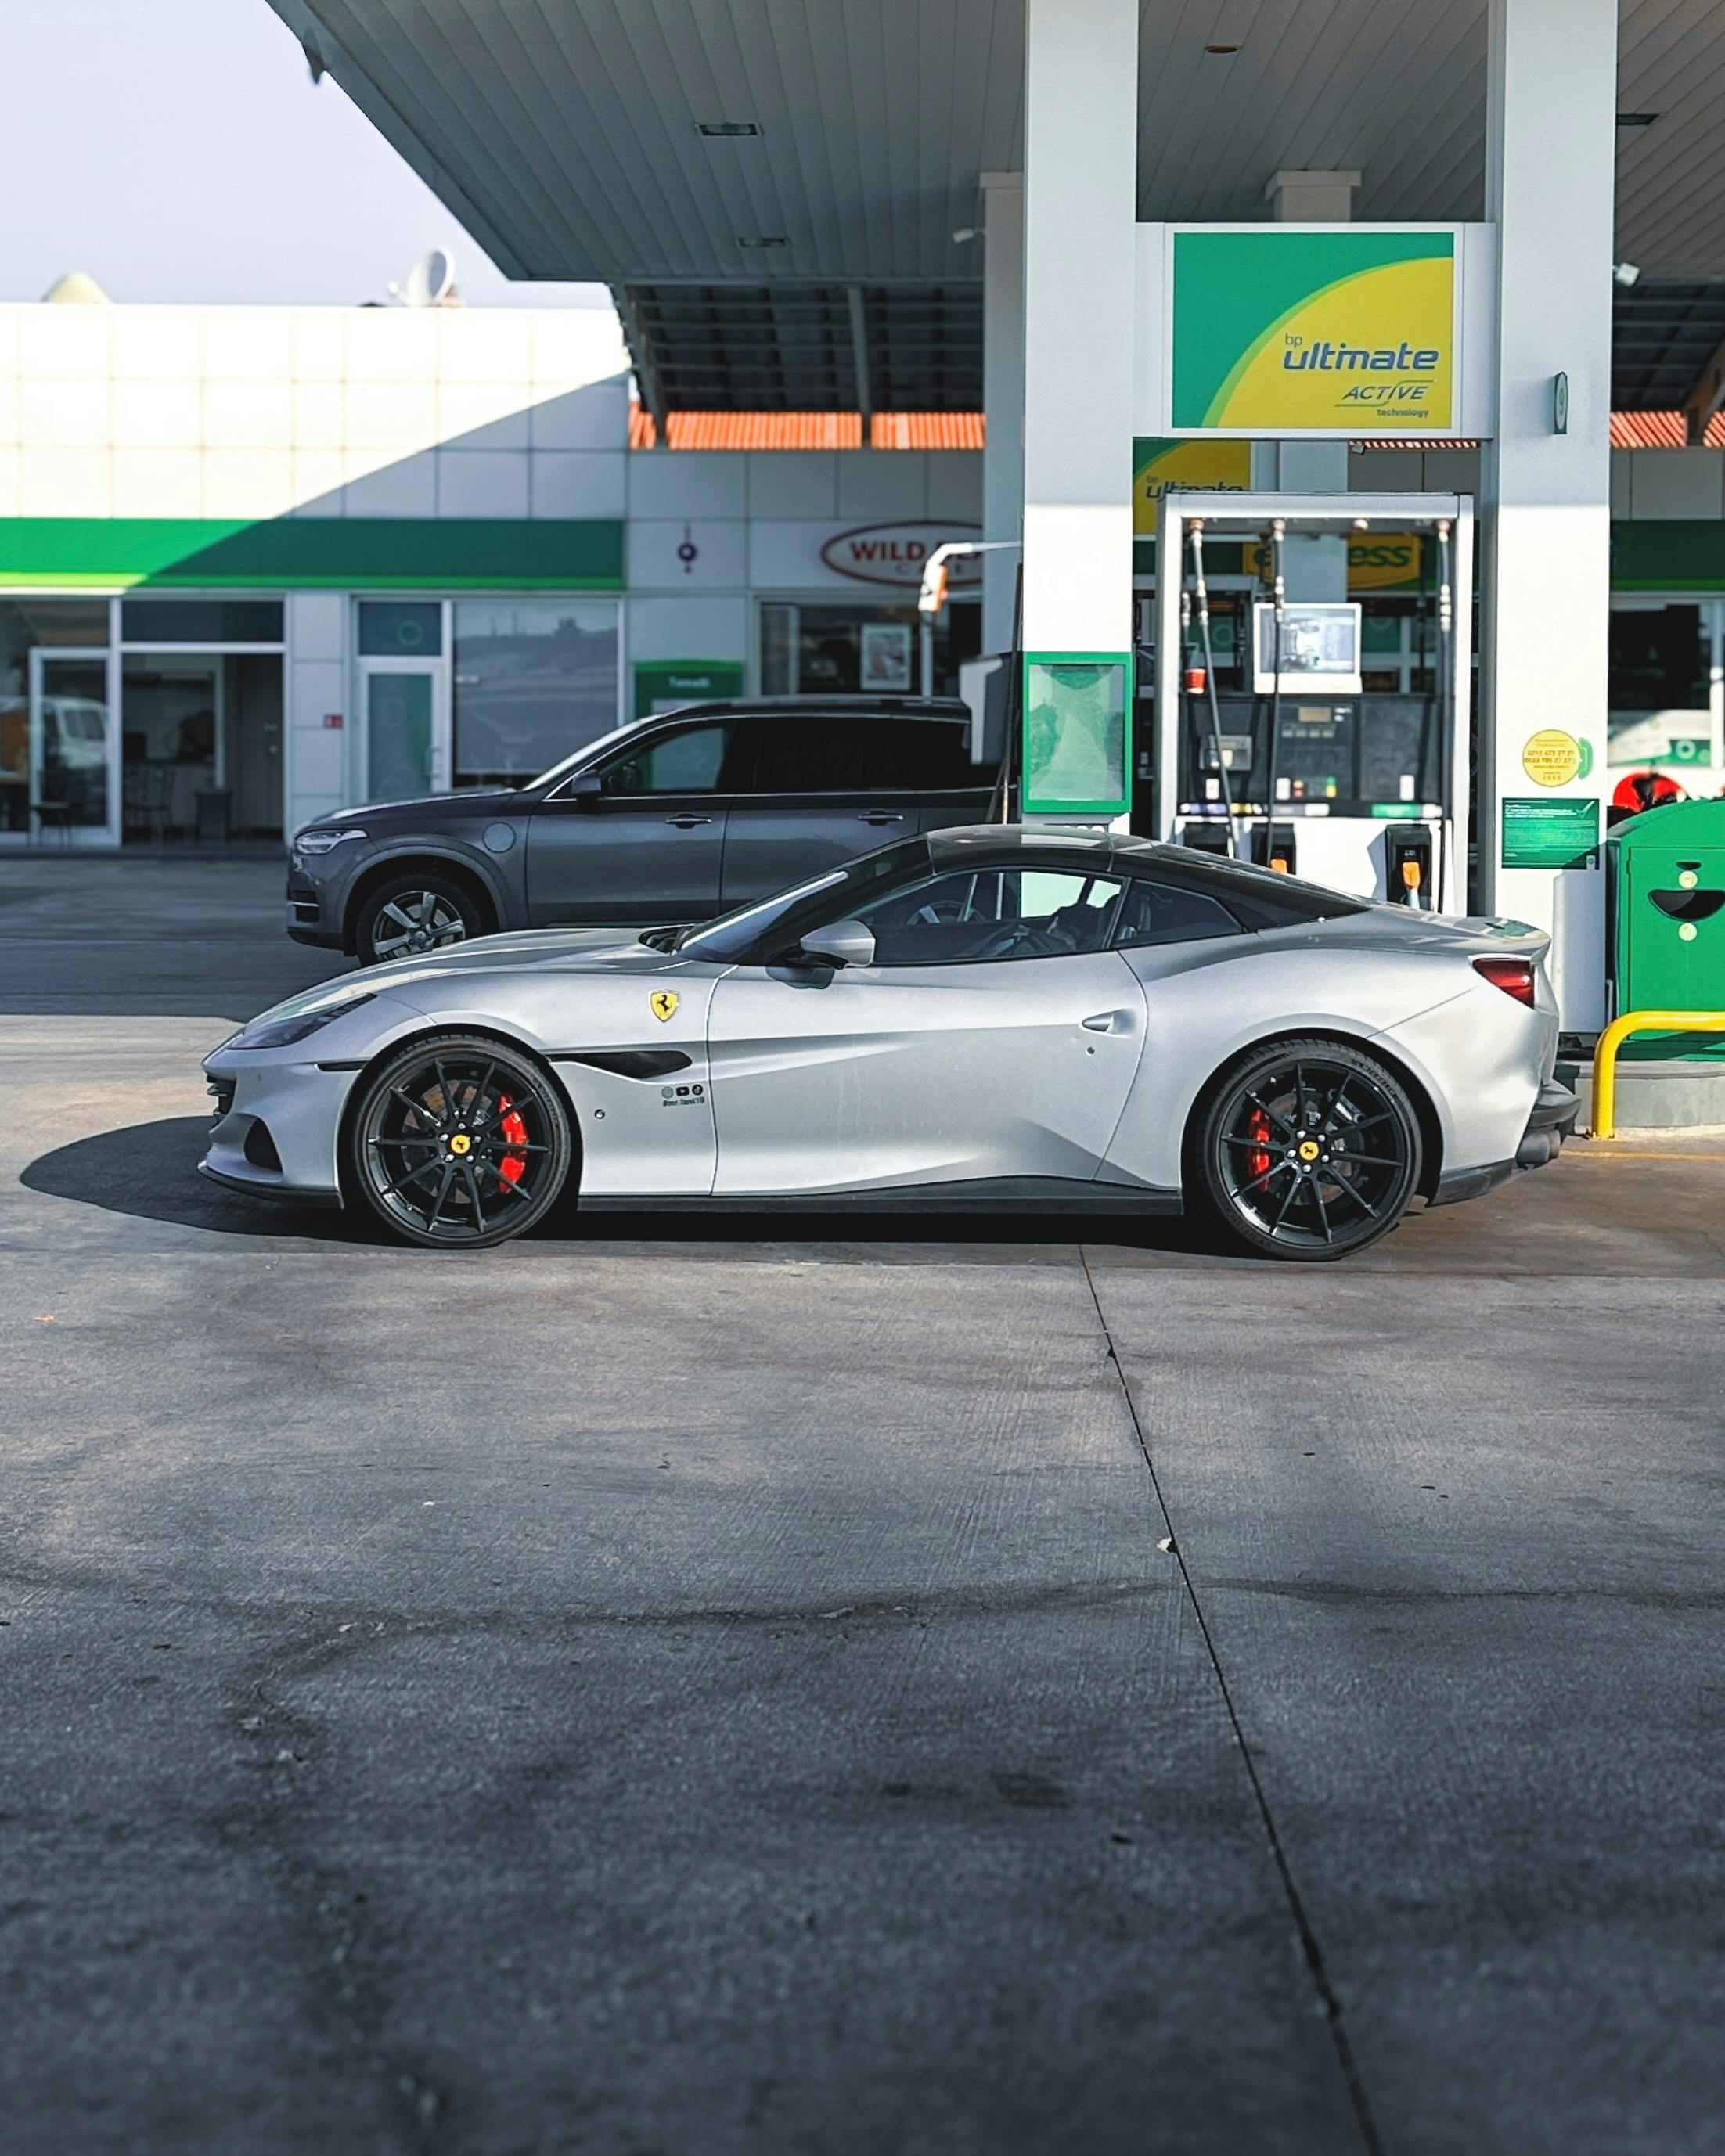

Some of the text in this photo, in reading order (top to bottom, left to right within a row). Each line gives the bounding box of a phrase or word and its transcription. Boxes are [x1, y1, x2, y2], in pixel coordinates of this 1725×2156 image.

[1285, 333, 1303, 347] bp
[1284, 342, 1439, 370] ultimate
[1341, 385, 1428, 400] ACTIVE
[1377, 409, 1430, 418] technology
[850, 542, 925, 561] WILD
